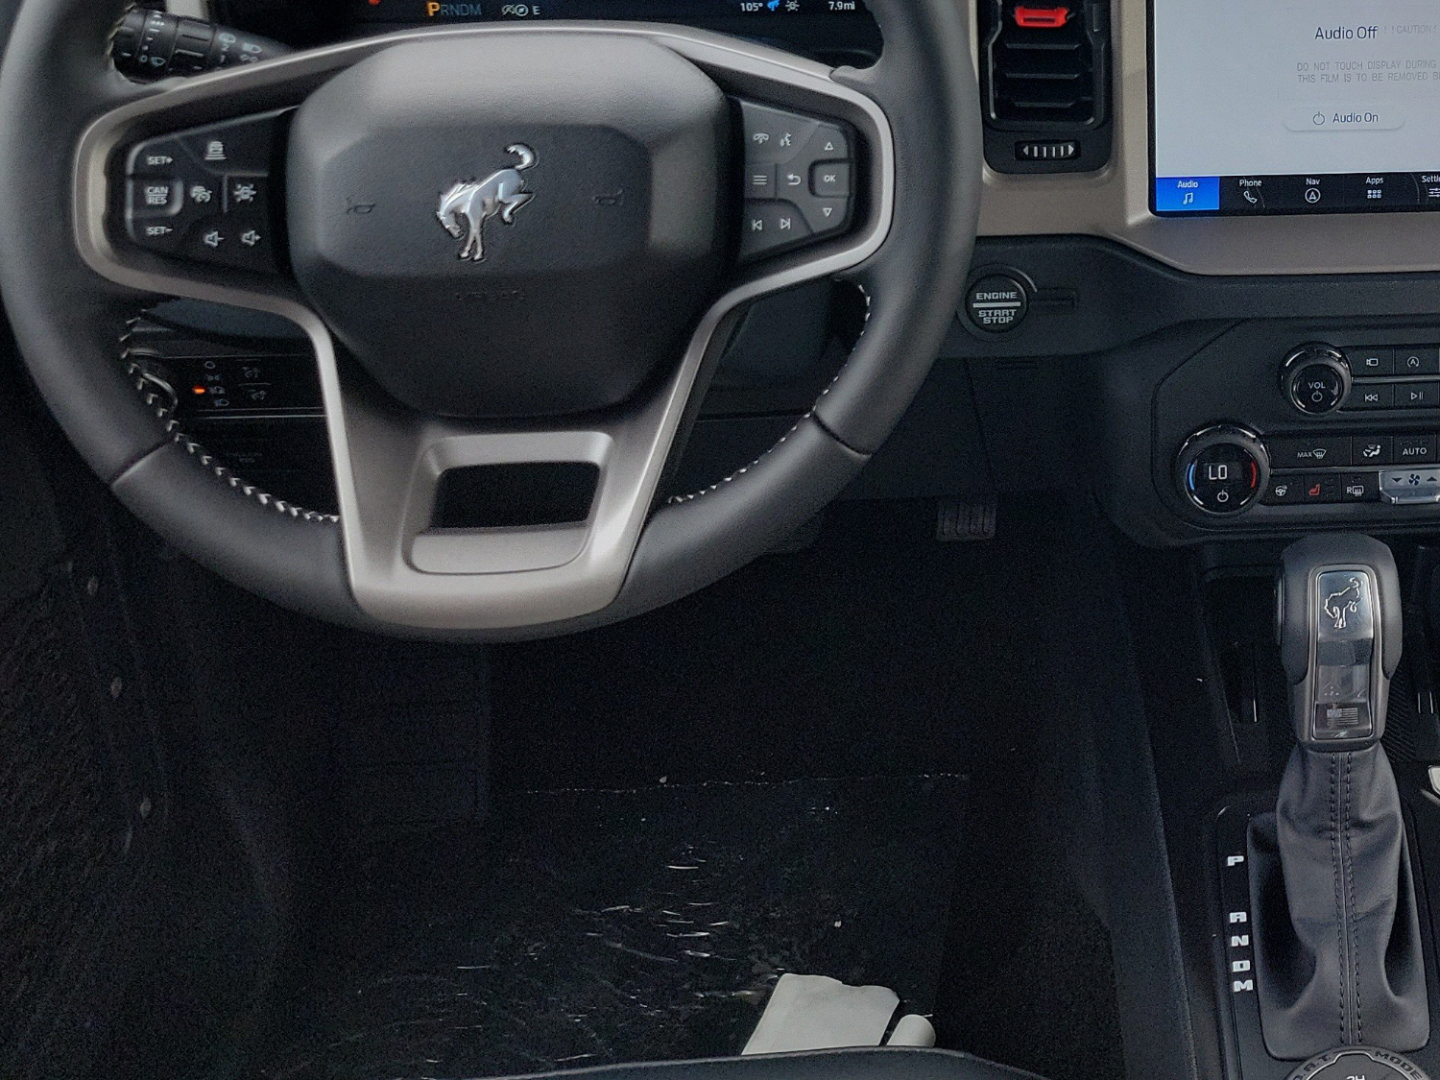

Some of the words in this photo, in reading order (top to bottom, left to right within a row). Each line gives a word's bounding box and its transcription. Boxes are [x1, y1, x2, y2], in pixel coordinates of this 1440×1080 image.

[1315, 26, 1354, 40] Audio
[1356, 25, 1378, 40] Off
[1296, 62, 1309, 71] DO
[1313, 61, 1330, 71] NOT
[1335, 61, 1363, 71] TOUCH
[1368, 60, 1400, 70] DISPLAY
[1405, 59, 1437, 69] DURING
[1298, 74, 1316, 83] THIS
[1320, 73, 1339, 83] FILM
[1344, 73, 1352, 82] IS
[1357, 73, 1367, 82] TO
[1371, 72, 1384, 82] BE
[1388, 71, 1429, 81] REMOVED
[1332, 112, 1362, 123] Audio
[1364, 112, 1379, 123] On
[823, 174, 836, 183] OK
[1239, 179, 1262, 187] Phone
[1366, 176, 1384, 185] Apps
[1177, 180, 1199, 188] Audio
[147, 186, 169, 195] CAN
[147, 196, 168, 205] RES
[976, 291, 1018, 300] ENGINE
[978, 309, 1016, 318] START
[983, 316, 1013, 325] STOP
[1308, 381, 1326, 390] VOL
[1297, 451, 1312, 459] MAX
[1402, 446, 1428, 455] AUTO
[1208, 464, 1228, 480] LO
[1226, 855, 1245, 867] P
[1229, 911, 1247, 924] R
[1231, 934, 1249, 947] N
[1232, 959, 1251, 973] D
[1233, 979, 1254, 993] M
